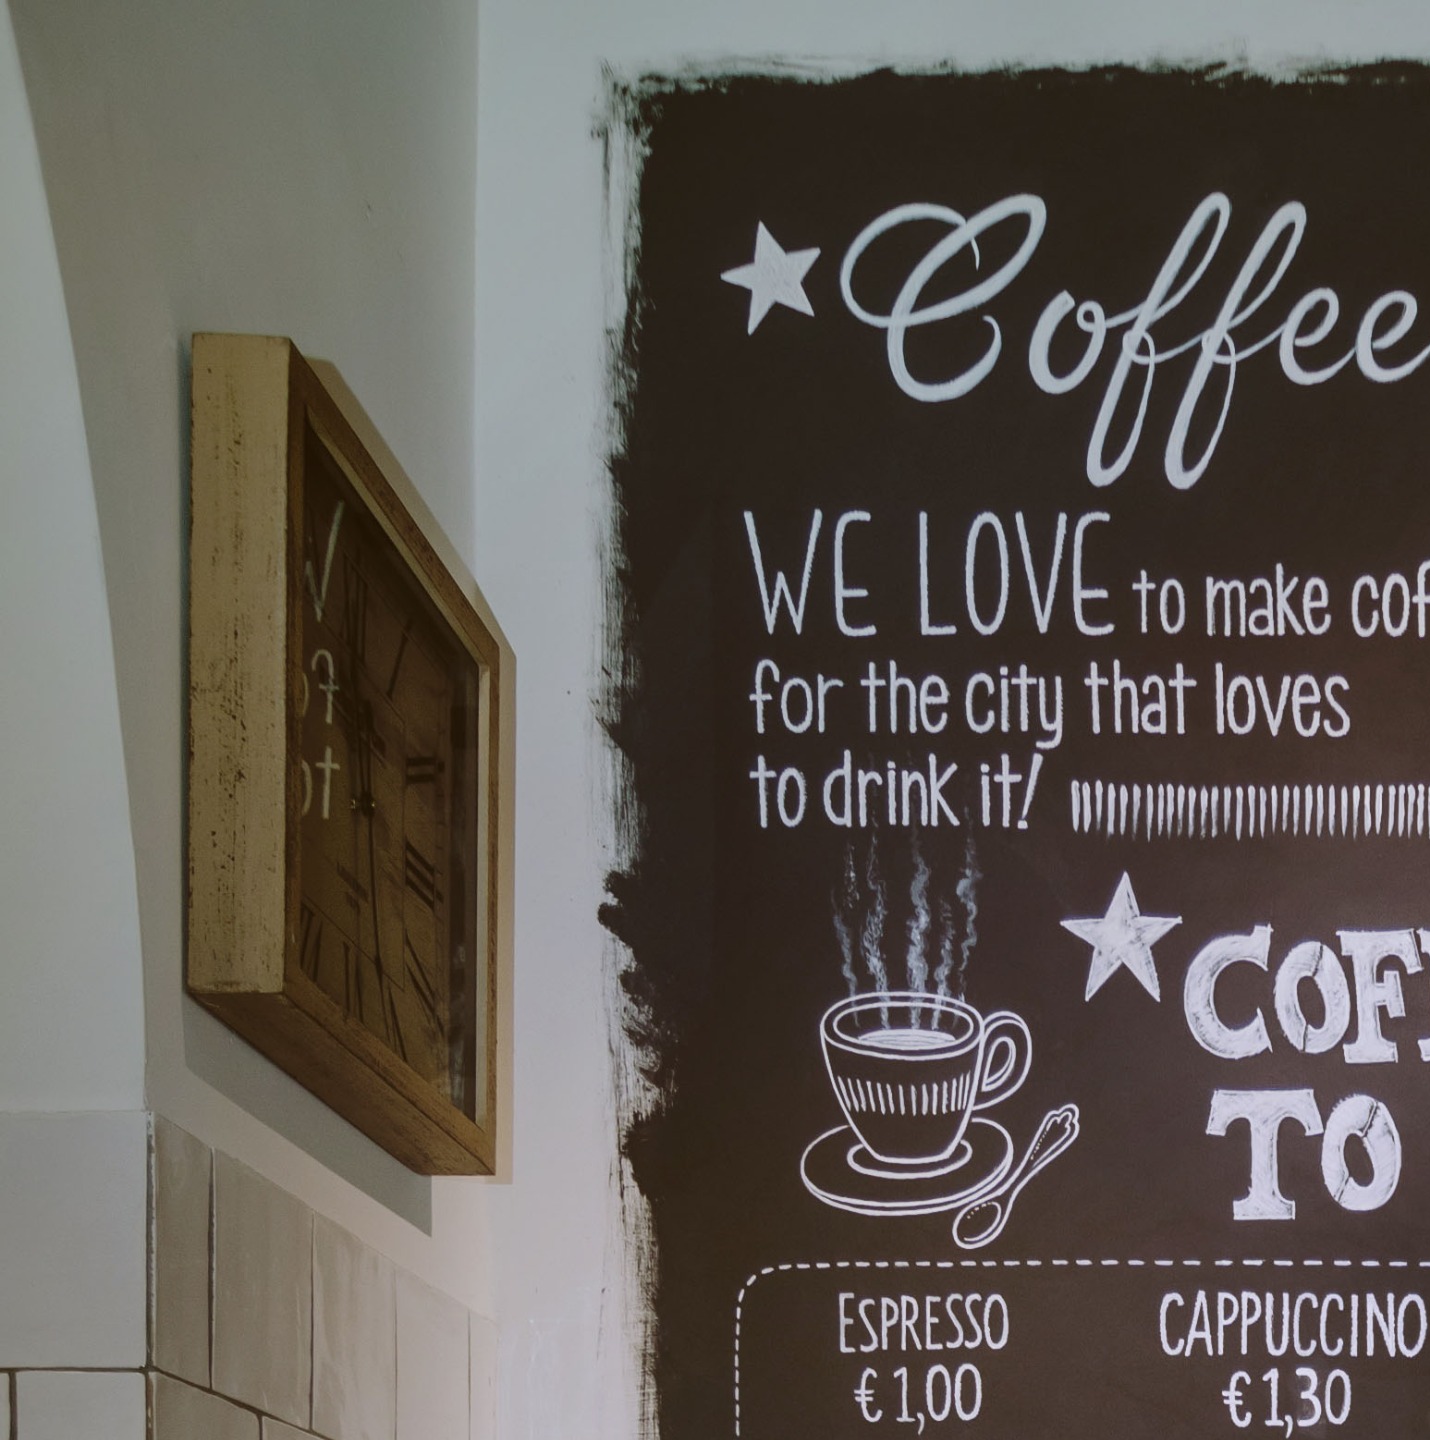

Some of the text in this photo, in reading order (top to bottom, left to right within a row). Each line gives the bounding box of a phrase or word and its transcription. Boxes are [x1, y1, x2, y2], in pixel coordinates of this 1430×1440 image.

[743, 508, 877, 637] WE
[919, 511, 1115, 636] LOVE
[1132, 569, 1186, 634] to
[1205, 562, 1332, 637] make
[749, 658, 1351, 750] for the city that loves
[749, 749, 1044, 830] to drink it!
[1205, 1088, 1402, 1221] TO
[838, 1292, 1009, 1354] ESPRESSO
[1159, 1289, 1428, 1358] CAPPUCCINO
